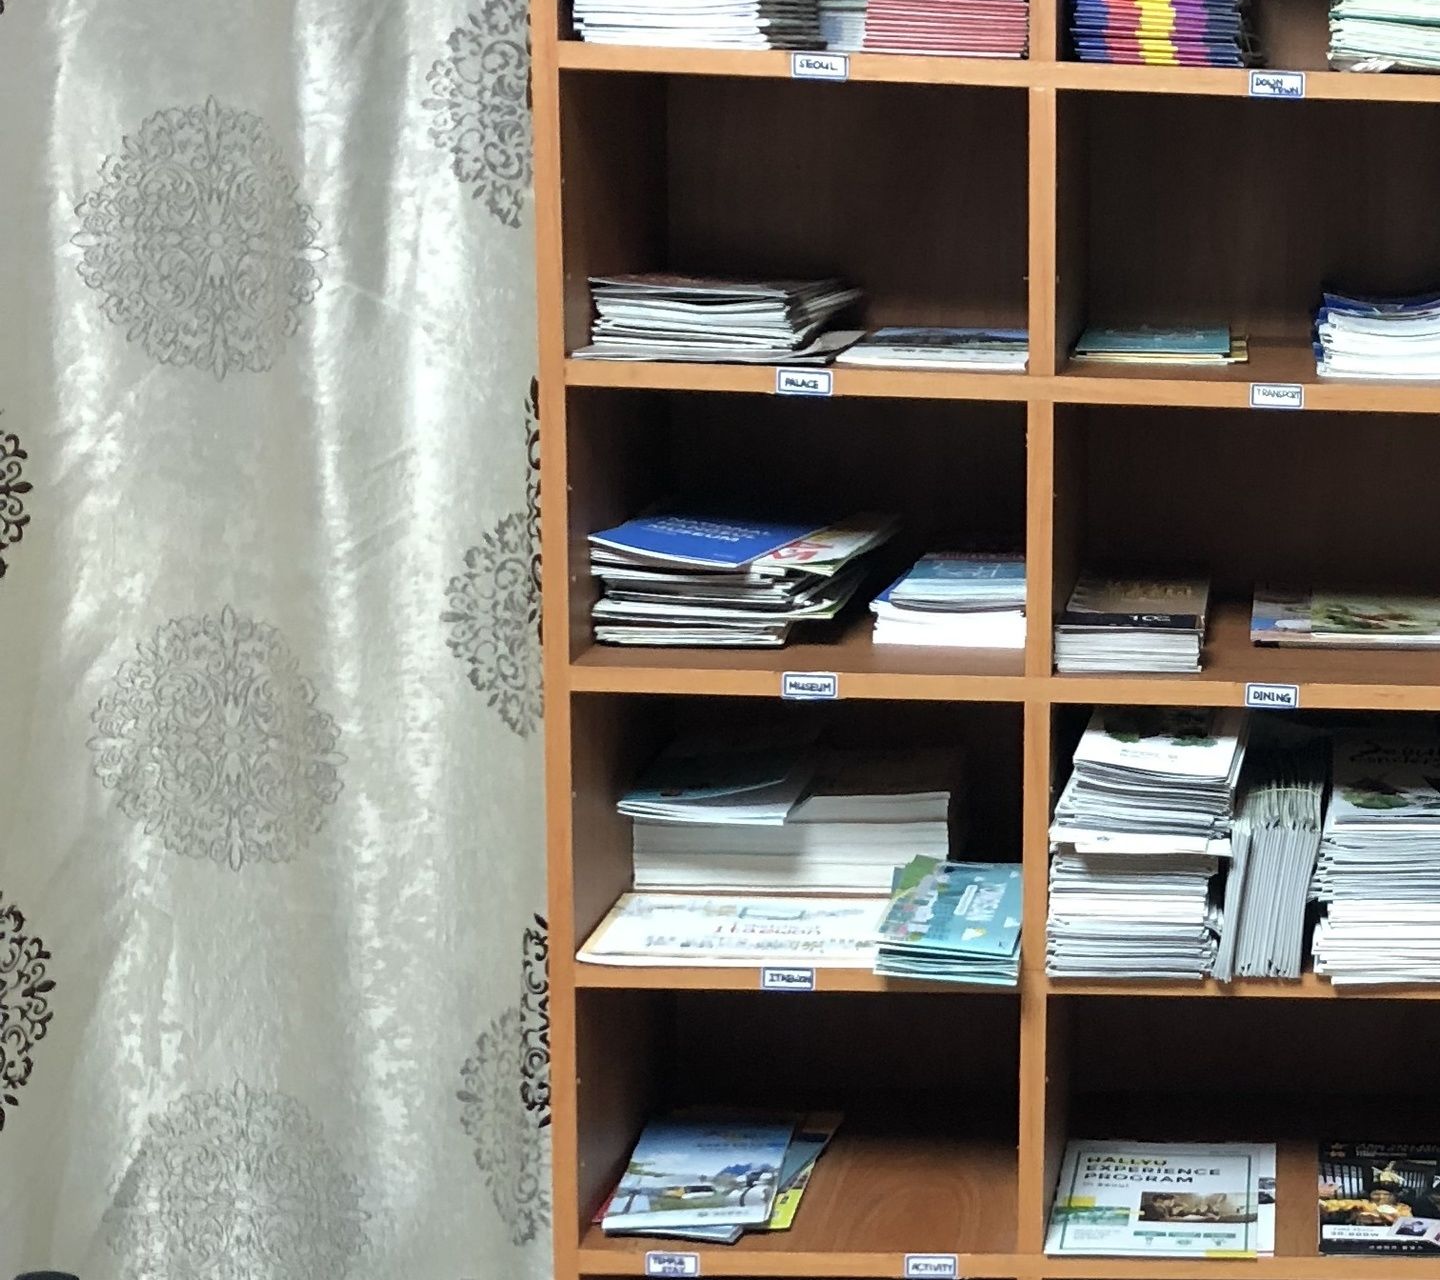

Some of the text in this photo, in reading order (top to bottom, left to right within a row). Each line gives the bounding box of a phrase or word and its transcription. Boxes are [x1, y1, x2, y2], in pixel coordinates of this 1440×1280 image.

[799, 59, 838, 71] SEOUL
[785, 378, 819, 389] PALACE
[1257, 388, 1301, 399] TRANSPORT
[789, 681, 831, 693] MUSEUM
[1253, 691, 1291, 704] DINING
[1087, 1156, 1167, 1166] HALLYU
[1086, 1165, 1221, 1176] EXPERIENCE
[1084, 1172, 1193, 1184] PROGRAM
